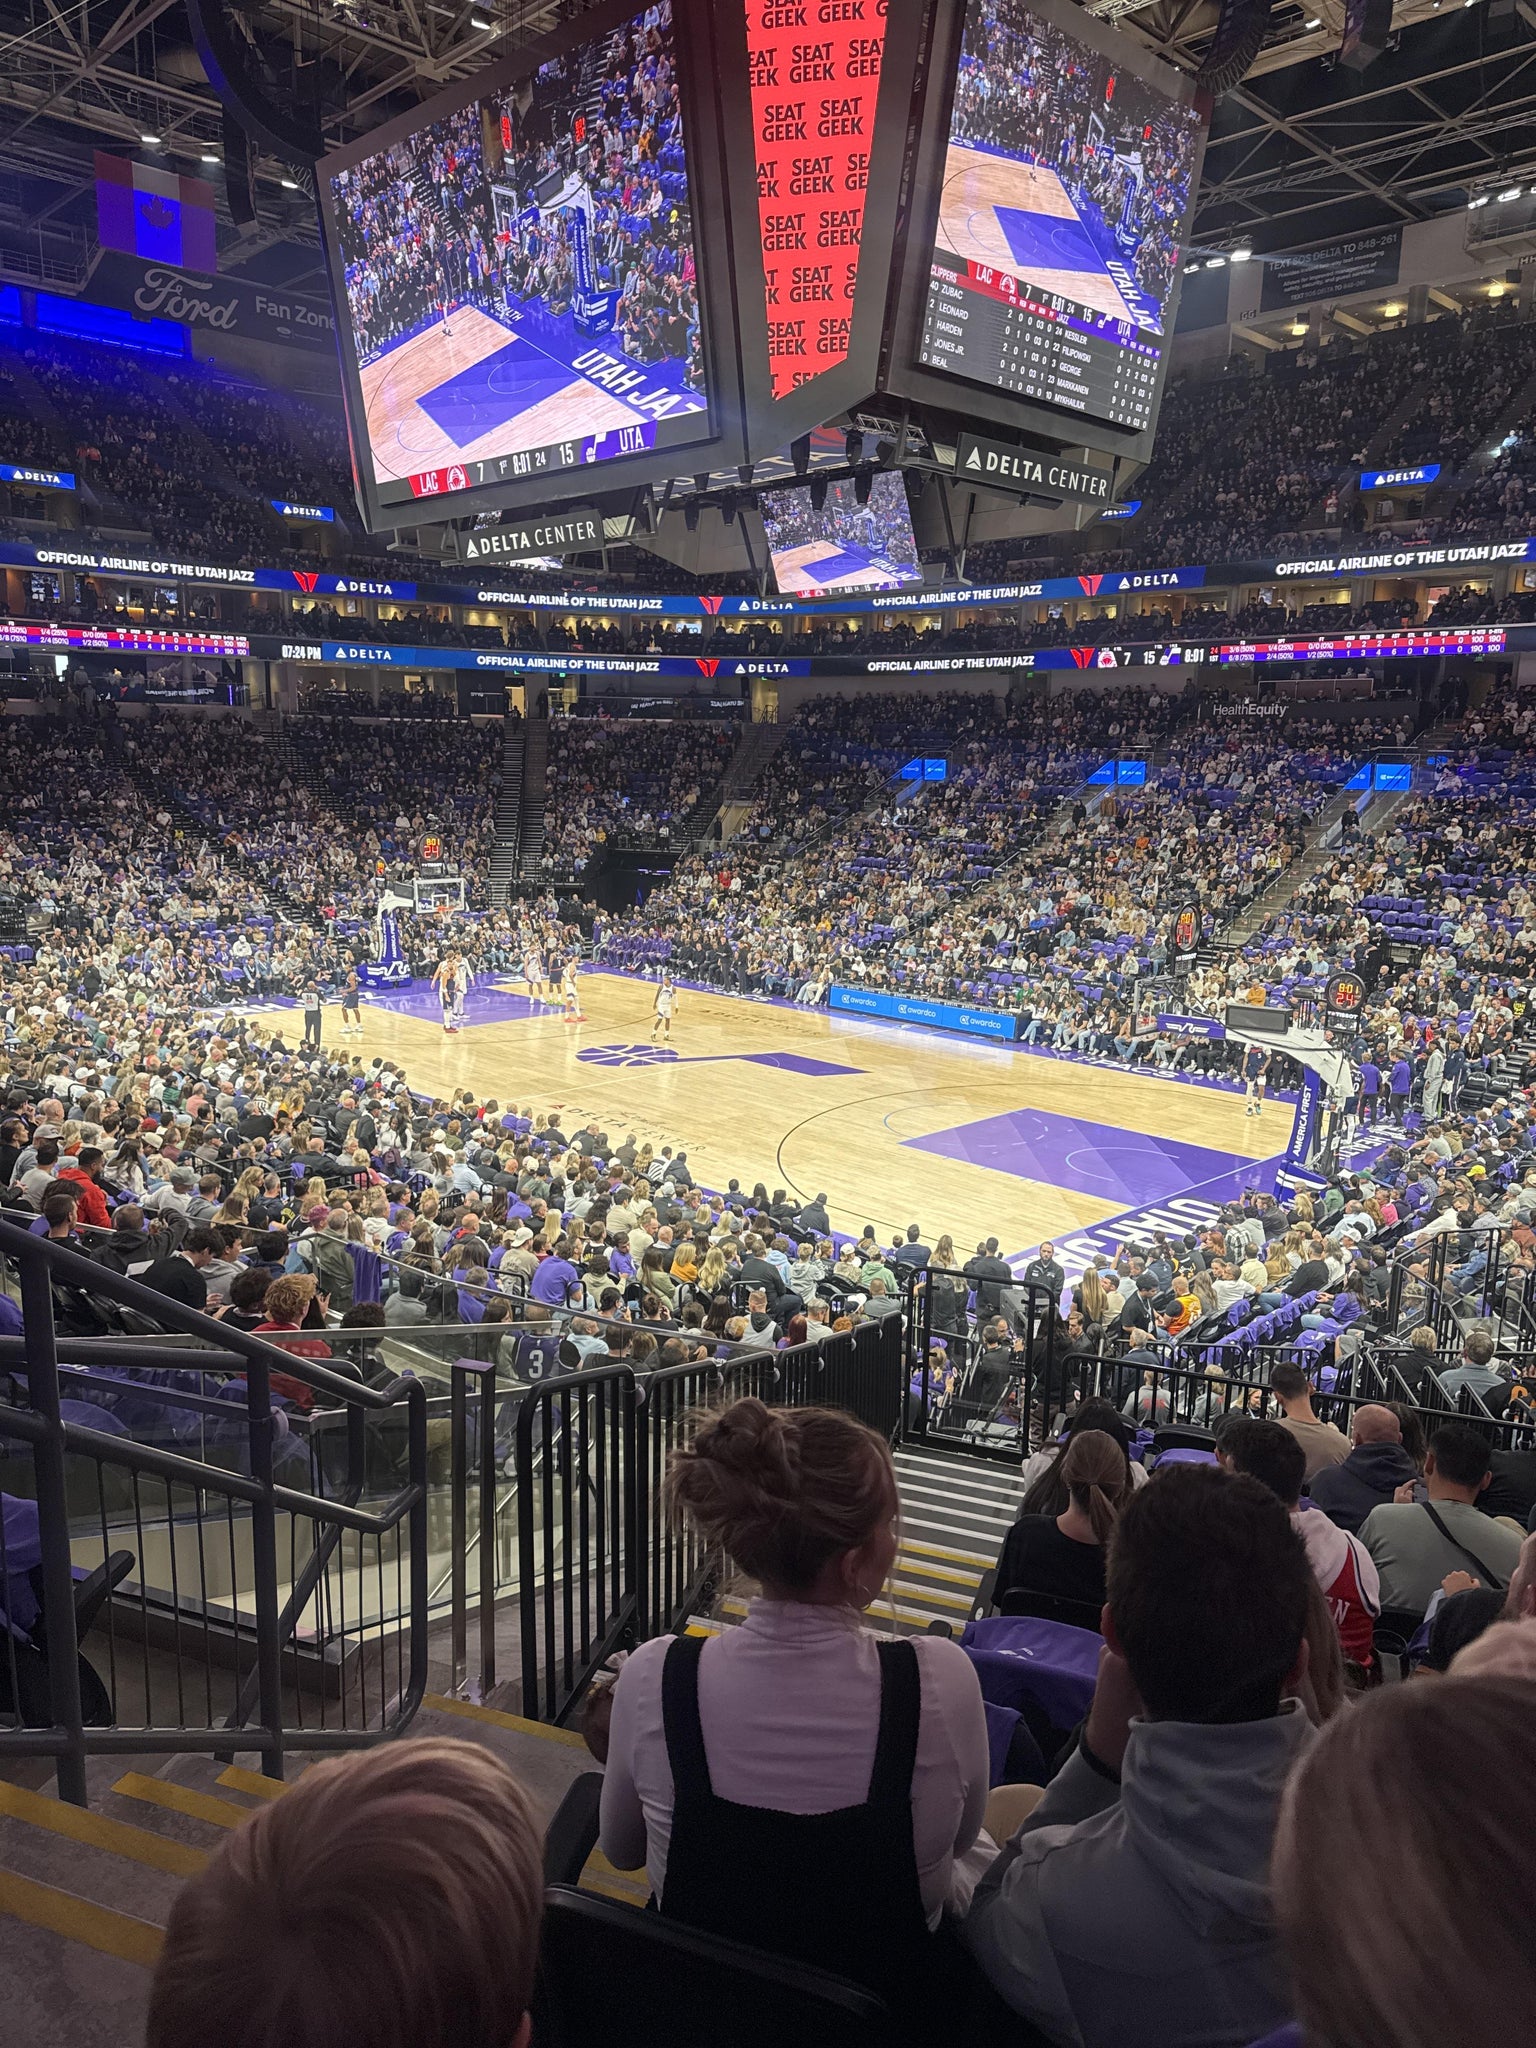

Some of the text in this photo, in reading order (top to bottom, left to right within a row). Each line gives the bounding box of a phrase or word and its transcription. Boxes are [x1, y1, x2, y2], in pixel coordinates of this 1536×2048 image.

[762, 8, 807, 29] GEEK
[818, 2, 864, 23] GEEK
[792, 42, 834, 64] SEAT
[790, 62, 835, 83] GEEK
[846, 58, 878, 78] GEE
[764, 102, 805, 123] SEAT
[820, 97, 862, 118] SEAT
[762, 122, 807, 142] GEEK
[818, 117, 863, 138] GEEK
[792, 156, 833, 176] SEAT
[790, 175, 834, 195] GEEK
[765, 213, 805, 233] SEAT
[820, 209, 860, 229] SEAT
[763, 232, 807, 251] GEEK
[817, 228, 861, 247] GEEK
[1269, 259, 1290, 271] TEXT
[1292, 254, 1312, 266] SOS
[1313, 247, 1342, 260] DELTA
[1342, 244, 1356, 253] TO
[1358, 234, 1397, 250] 848-261
[792, 265, 832, 284] SEAT
[931, 264, 958, 283] CLIPPERS
[790, 284, 833, 302] GEEK
[930, 281, 963, 300] 40 ZUBAC
[1106, 261, 1140, 308] UTAH
[134, 268, 335, 329] Ford Fan Zone
[976, 265, 992, 284] LAC
[1026, 285, 1031, 299] 7
[1051, 296, 1065, 311] 8:01
[1067, 303, 1074, 314] 24
[1083, 308, 1092, 323] 15
[1118, 321, 1131, 338] UTA
[930, 299, 968, 320] 2 LEONARD
[1057, 313, 1069, 324] JAZZ
[768, 320, 805, 339] SEAT
[937, 320, 962, 336] HARDEN
[1055, 325, 1087, 345] 24 KESSLER
[925, 335, 929, 343] 5
[934, 338, 955, 352] JONES
[1053, 343, 1060, 352] 22
[923, 353, 948, 368] 0 BEAL
[572, 348, 647, 394] UTAH
[1048, 375, 1054, 384] 23
[1046, 391, 1052, 400] 10
[420, 472, 439, 492] LAC
[477, 463, 484, 481] 7
[513, 452, 531, 474] 8:01
[536, 452, 546, 466] 24
[559, 443, 573, 464] 15
[619, 426, 644, 451] UTA
[26, 471, 61, 484] DELTA
[986, 452, 1106, 496] DELTA CENTER
[1387, 471, 1423, 482] DELTA
[293, 507, 322, 516] DELTA
[480, 521, 596, 554] DELTA CENTER
[37, 551, 254, 582] OFFICIAL AIRLINE OF THE UTAH JAZZ
[1276, 543, 1527, 575] OFFICIAL AIRLINE OF THE UTAH JAZZ
[350, 582, 392, 594] DELTA
[1134, 573, 1178, 587] DELTA
[478, 592, 662, 609] OFFICIAL AIRLINE OF THE UTAH JAZZ
[920, 591, 958, 604] AIRLINE
[959, 590, 971, 601] OF
[973, 588, 991, 599] THE
[993, 586, 1018, 598] UTAH
[1019, 585, 1042, 597] JAZZ
[282, 646, 321, 660] 07:24 PM
[350, 649, 391, 660] DELTA
[1124, 649, 1204, 665] 7 15 8:01
[477, 656, 659, 672] OFFICIAL AIRLINE OF THE UTAH JAZZ
[749, 664, 788, 672] DELTA
[868, 656, 1034, 672] OFFICIAL AIRLINE OF THE UTAH JAZZ
[1213, 704, 1287, 717] HealthEquity
[424, 846, 439, 858] 24
[1339, 983, 1359, 994] 8:01
[850, 996, 876, 1007] awardco
[1336, 993, 1354, 1006] 24
[908, 1007, 936, 1017] awardco
[970, 1019, 1001, 1029] awardco
[567, 1108, 628, 1128] DELTA
[631, 1128, 706, 1151] CENTER
[1293, 1085, 1312, 1156] AMERICA FIRST
[528, 1350, 543, 1378] 3
